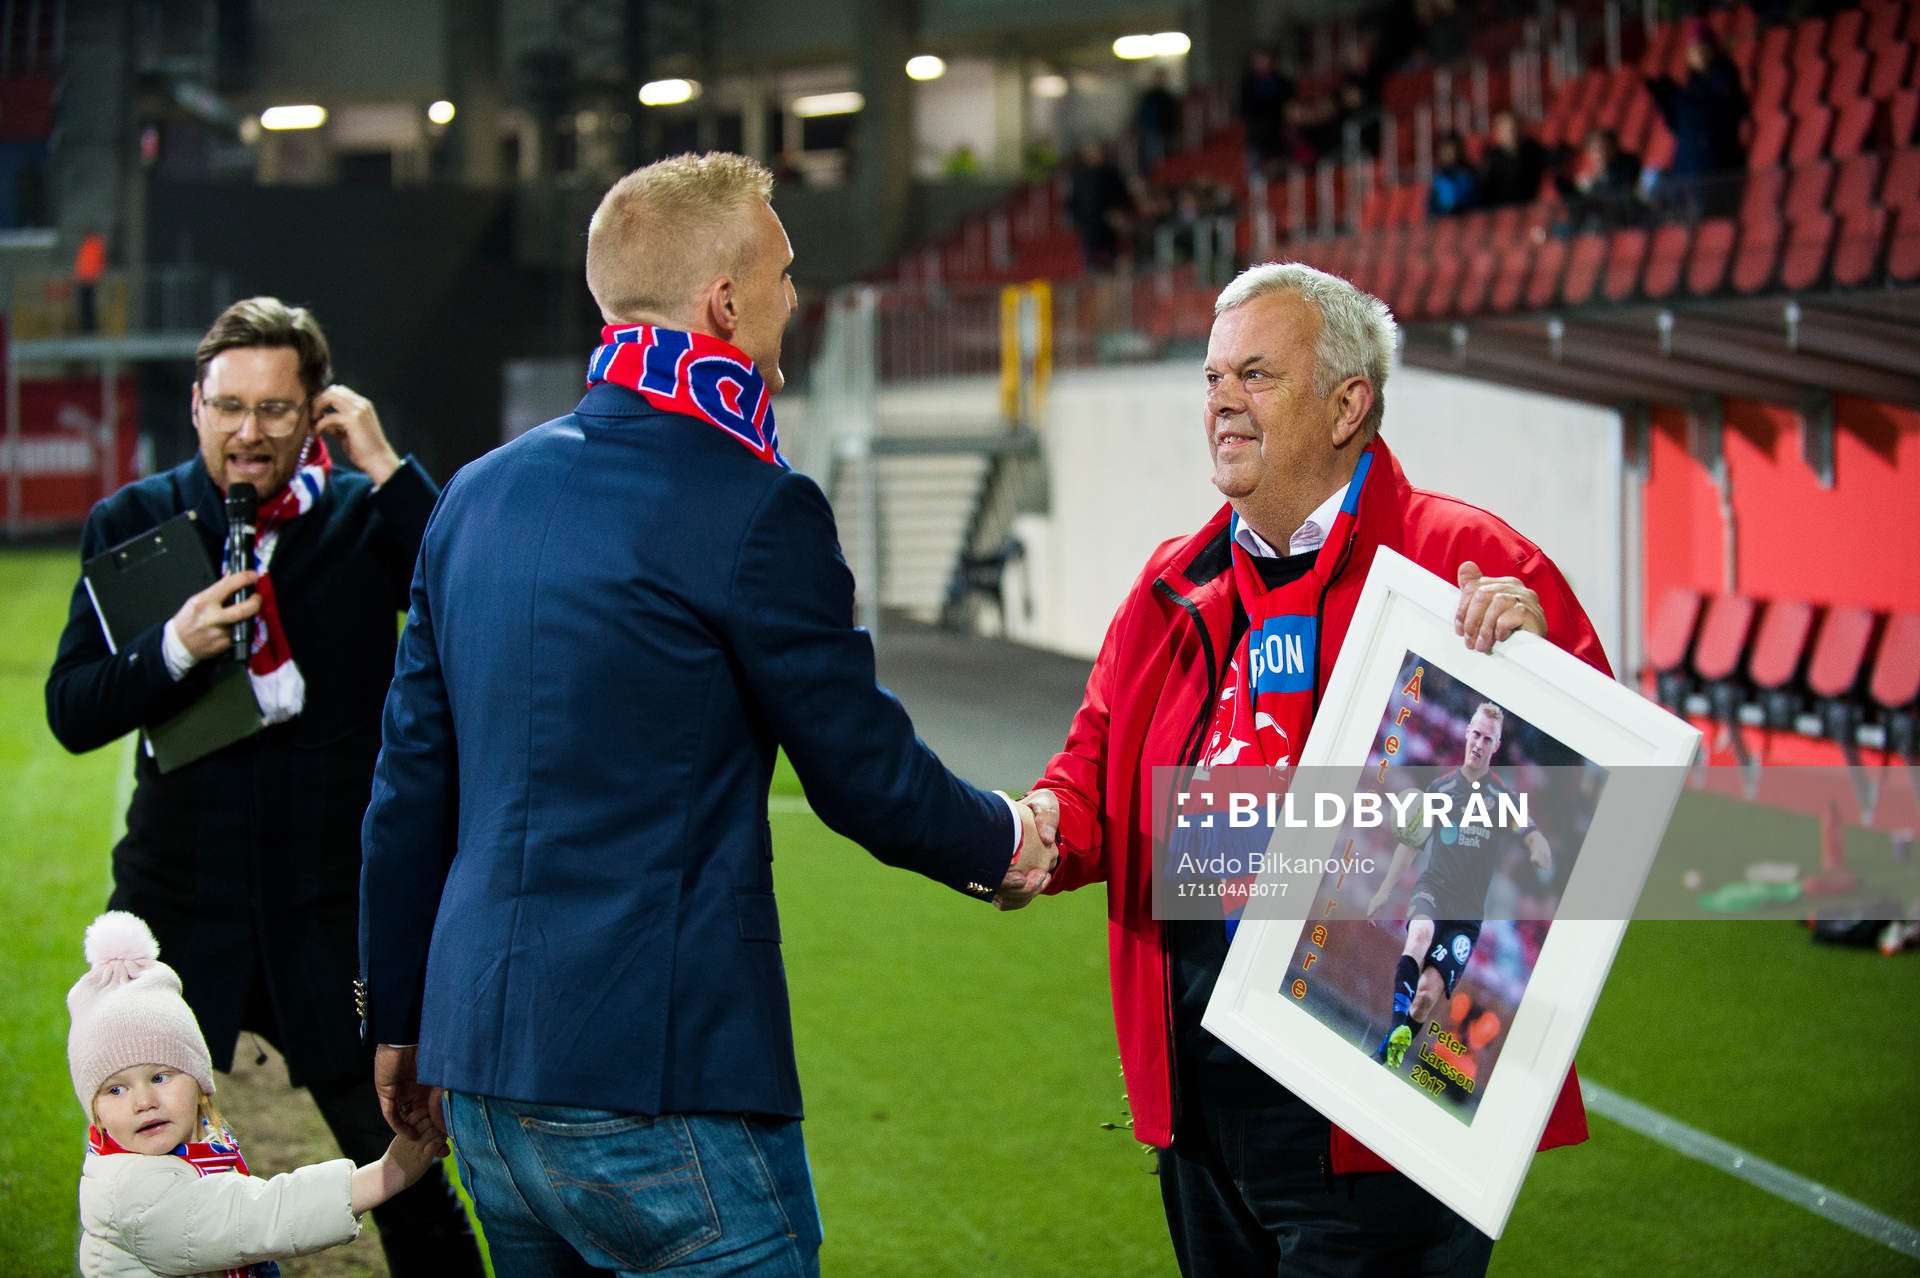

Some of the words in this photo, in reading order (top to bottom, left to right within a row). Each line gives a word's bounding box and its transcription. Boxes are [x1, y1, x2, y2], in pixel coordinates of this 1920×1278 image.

[1458, 834, 1481, 849] Bank
[1431, 944, 1448, 962] 26
[1427, 1019, 1468, 1057] Peter
[1409, 1064, 1446, 1097] 2017
[1418, 1041, 1476, 1093] Larsson
